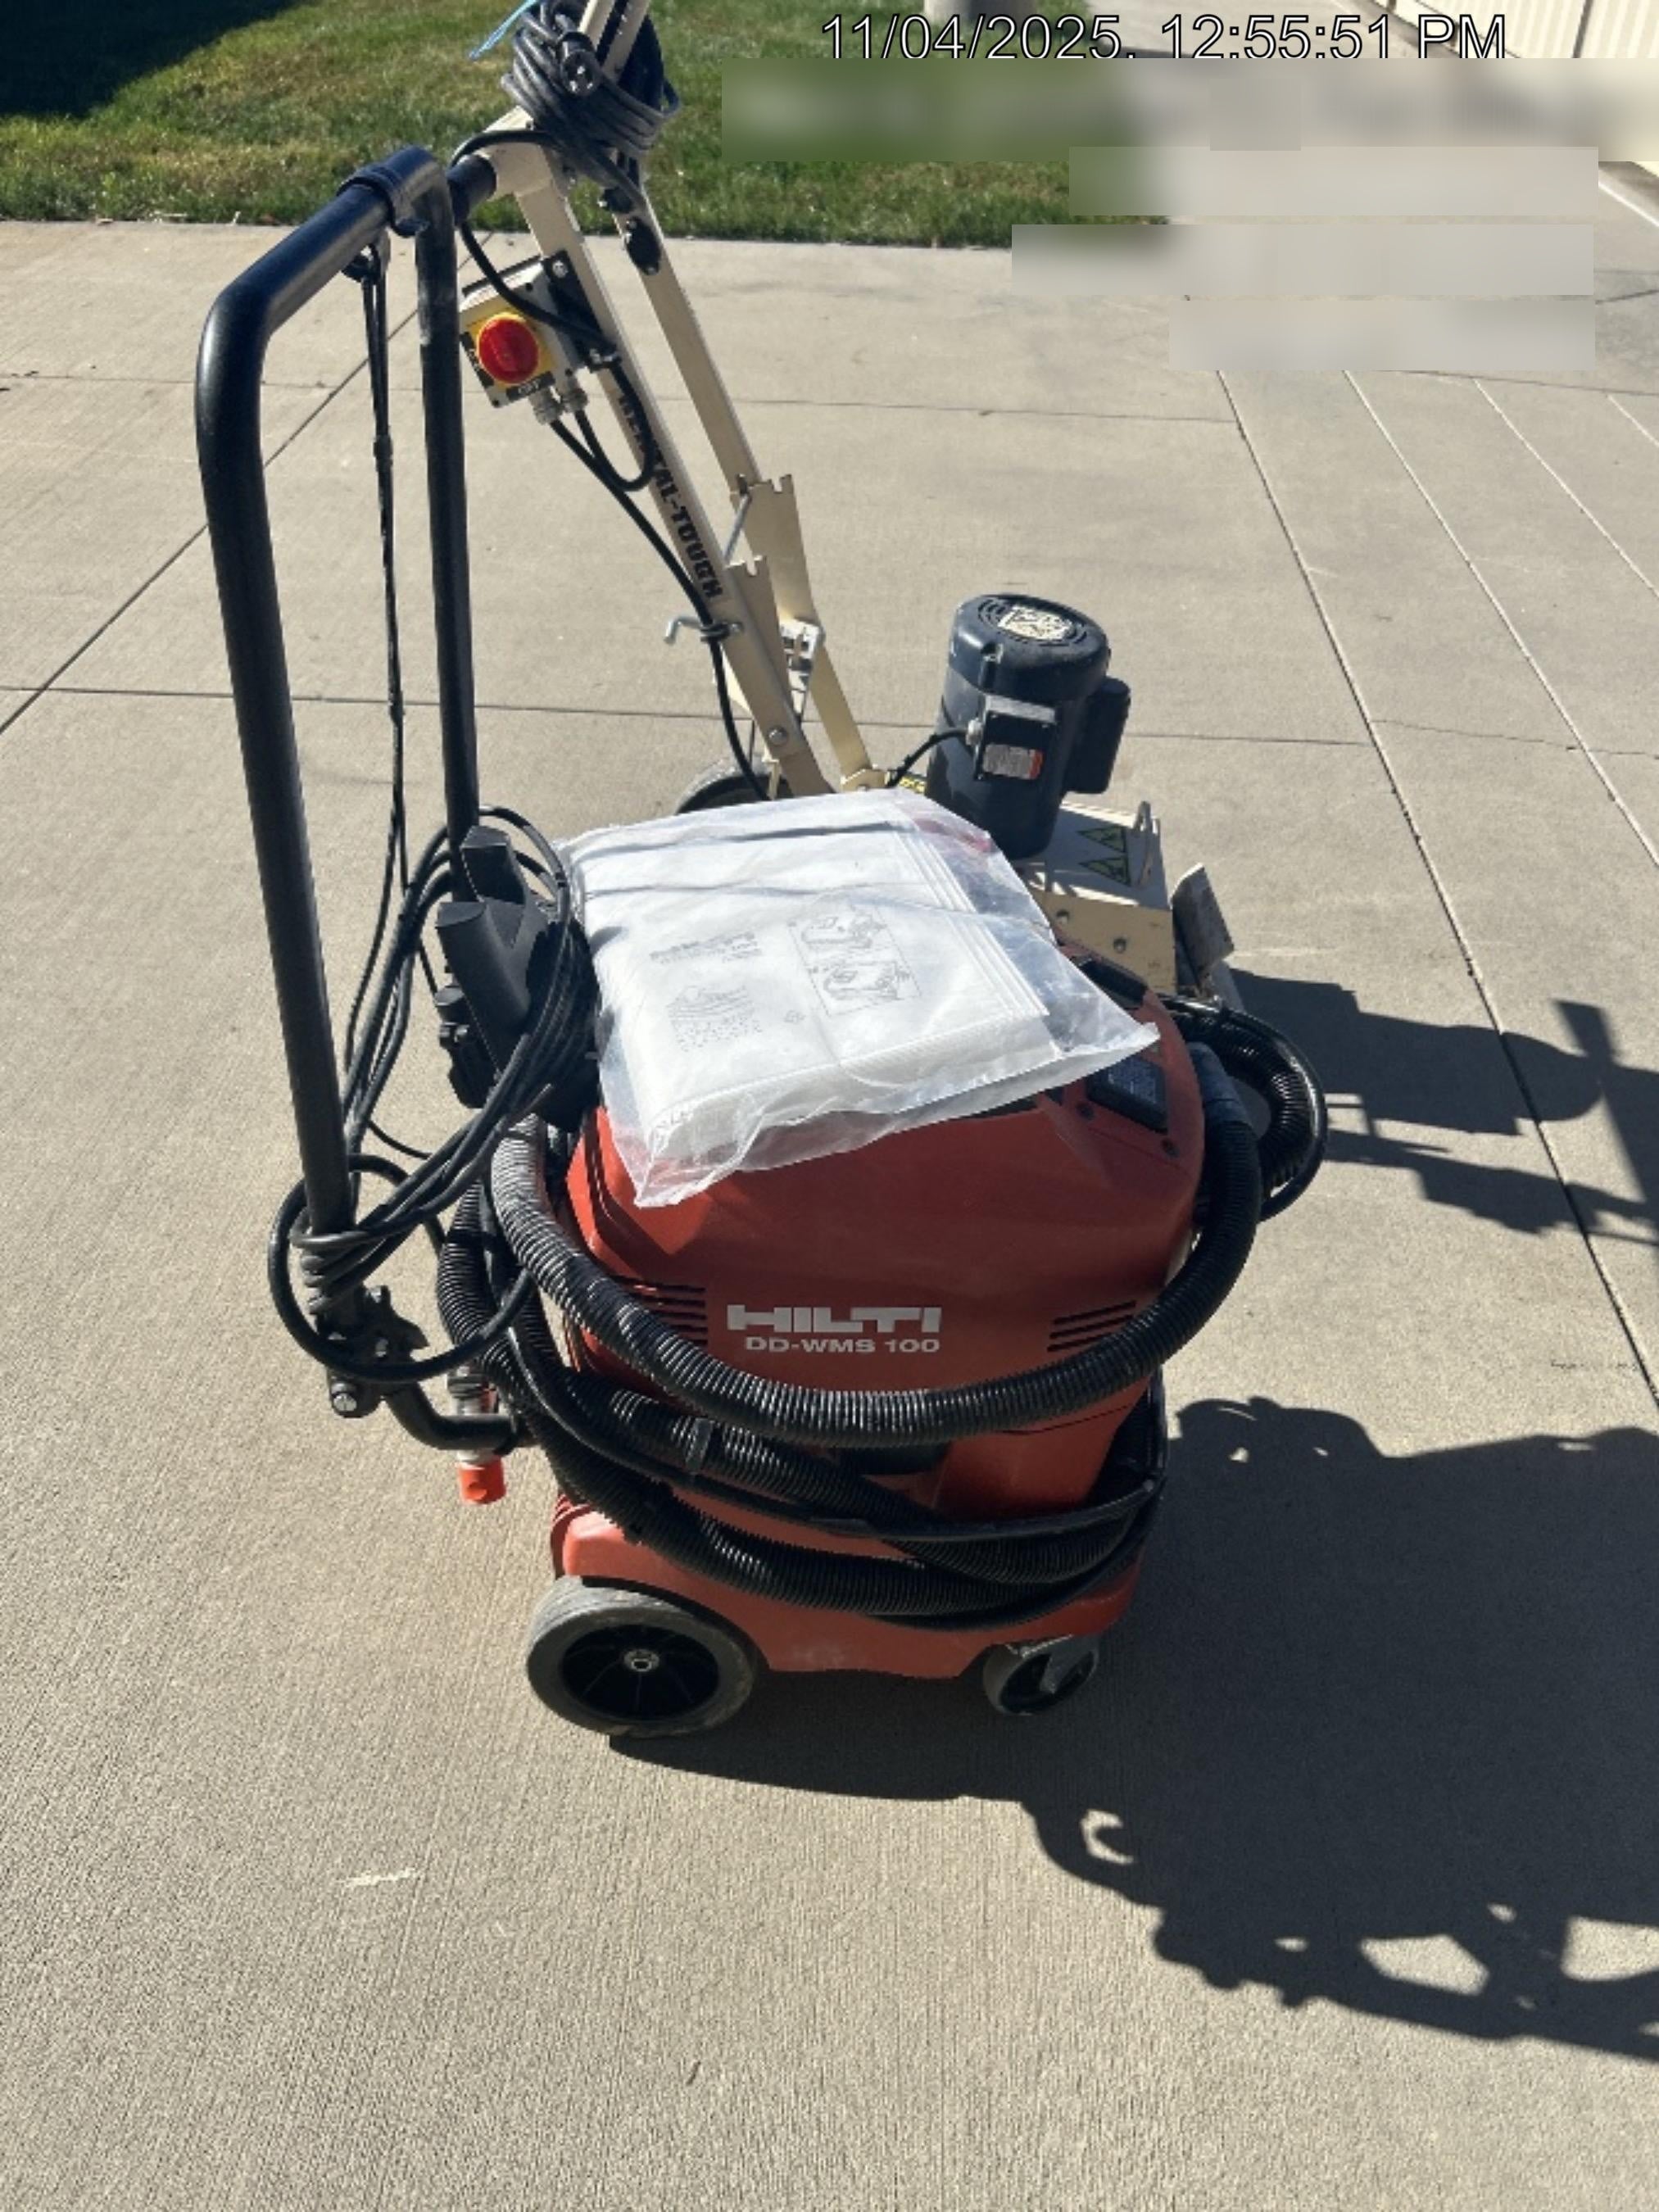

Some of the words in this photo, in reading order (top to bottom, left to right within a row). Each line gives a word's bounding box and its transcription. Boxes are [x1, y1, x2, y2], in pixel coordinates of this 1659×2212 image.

[727, 1304, 942, 1333] HILTI
[745, 1335, 876, 1353] DD-WMS
[884, 1338, 941, 1353] 100
